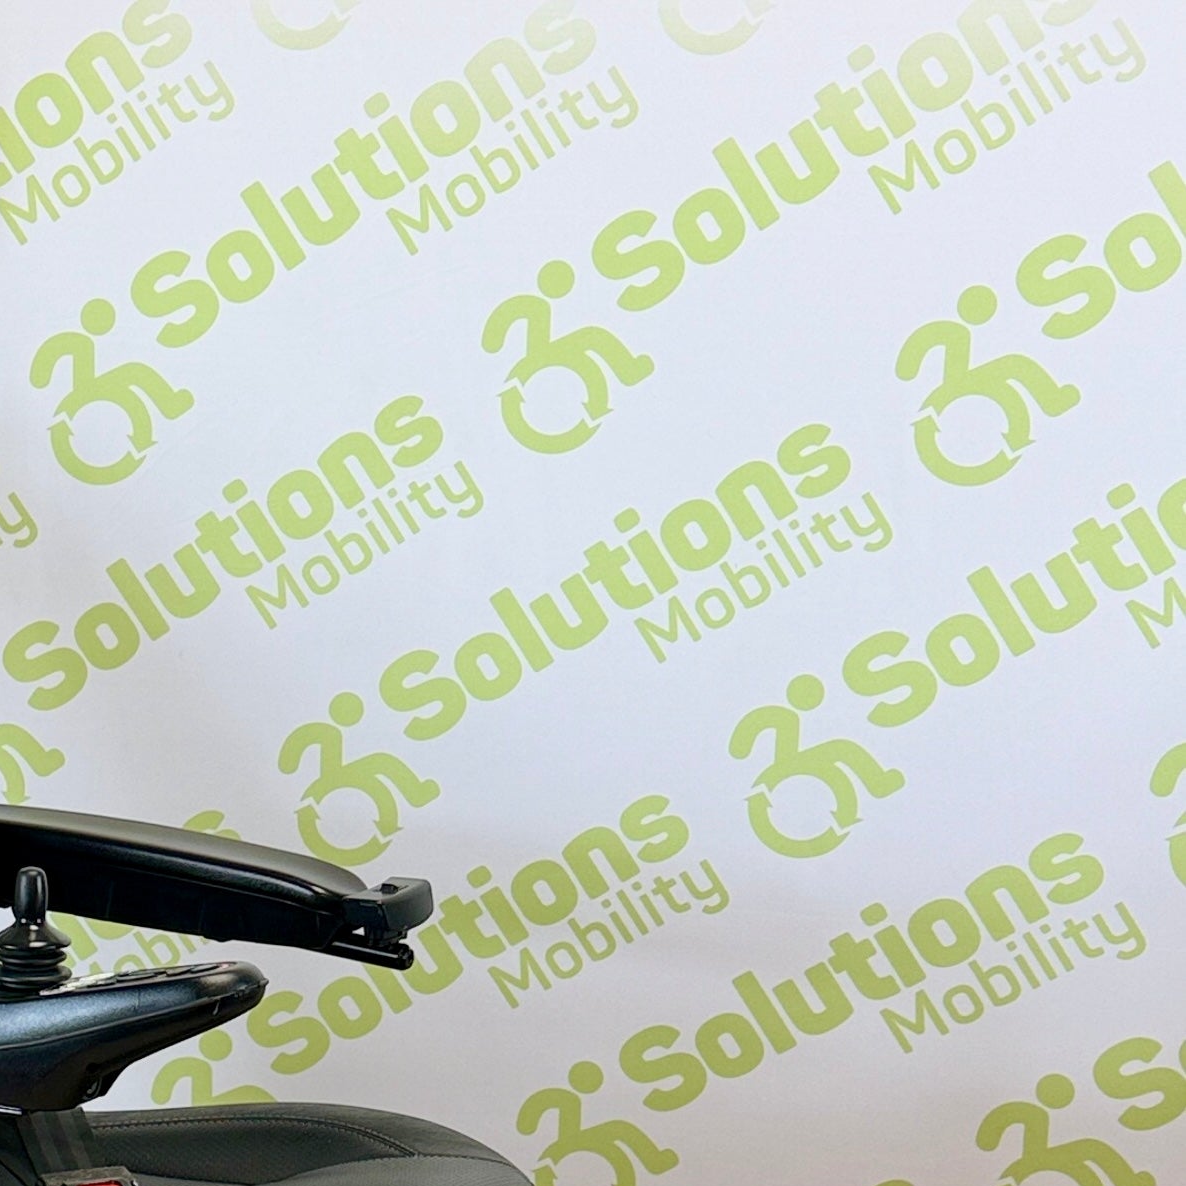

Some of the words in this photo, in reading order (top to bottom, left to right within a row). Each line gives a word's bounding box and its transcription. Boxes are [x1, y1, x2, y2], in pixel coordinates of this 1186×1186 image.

[130, 0, 596, 347] Solutions
[386, 66, 639, 254] Mobility
[868, 17, 1147, 214] Mobility
[2, 395, 443, 711] Solutions
[246, 461, 484, 629] Mobility
[379, 423, 851, 741] Solutions
[634, 492, 893, 662] Mobility
[488, 860, 730, 1008] Mobility
[619, 833, 1104, 1112] Solutions
[881, 903, 1147, 1053] Mobility
